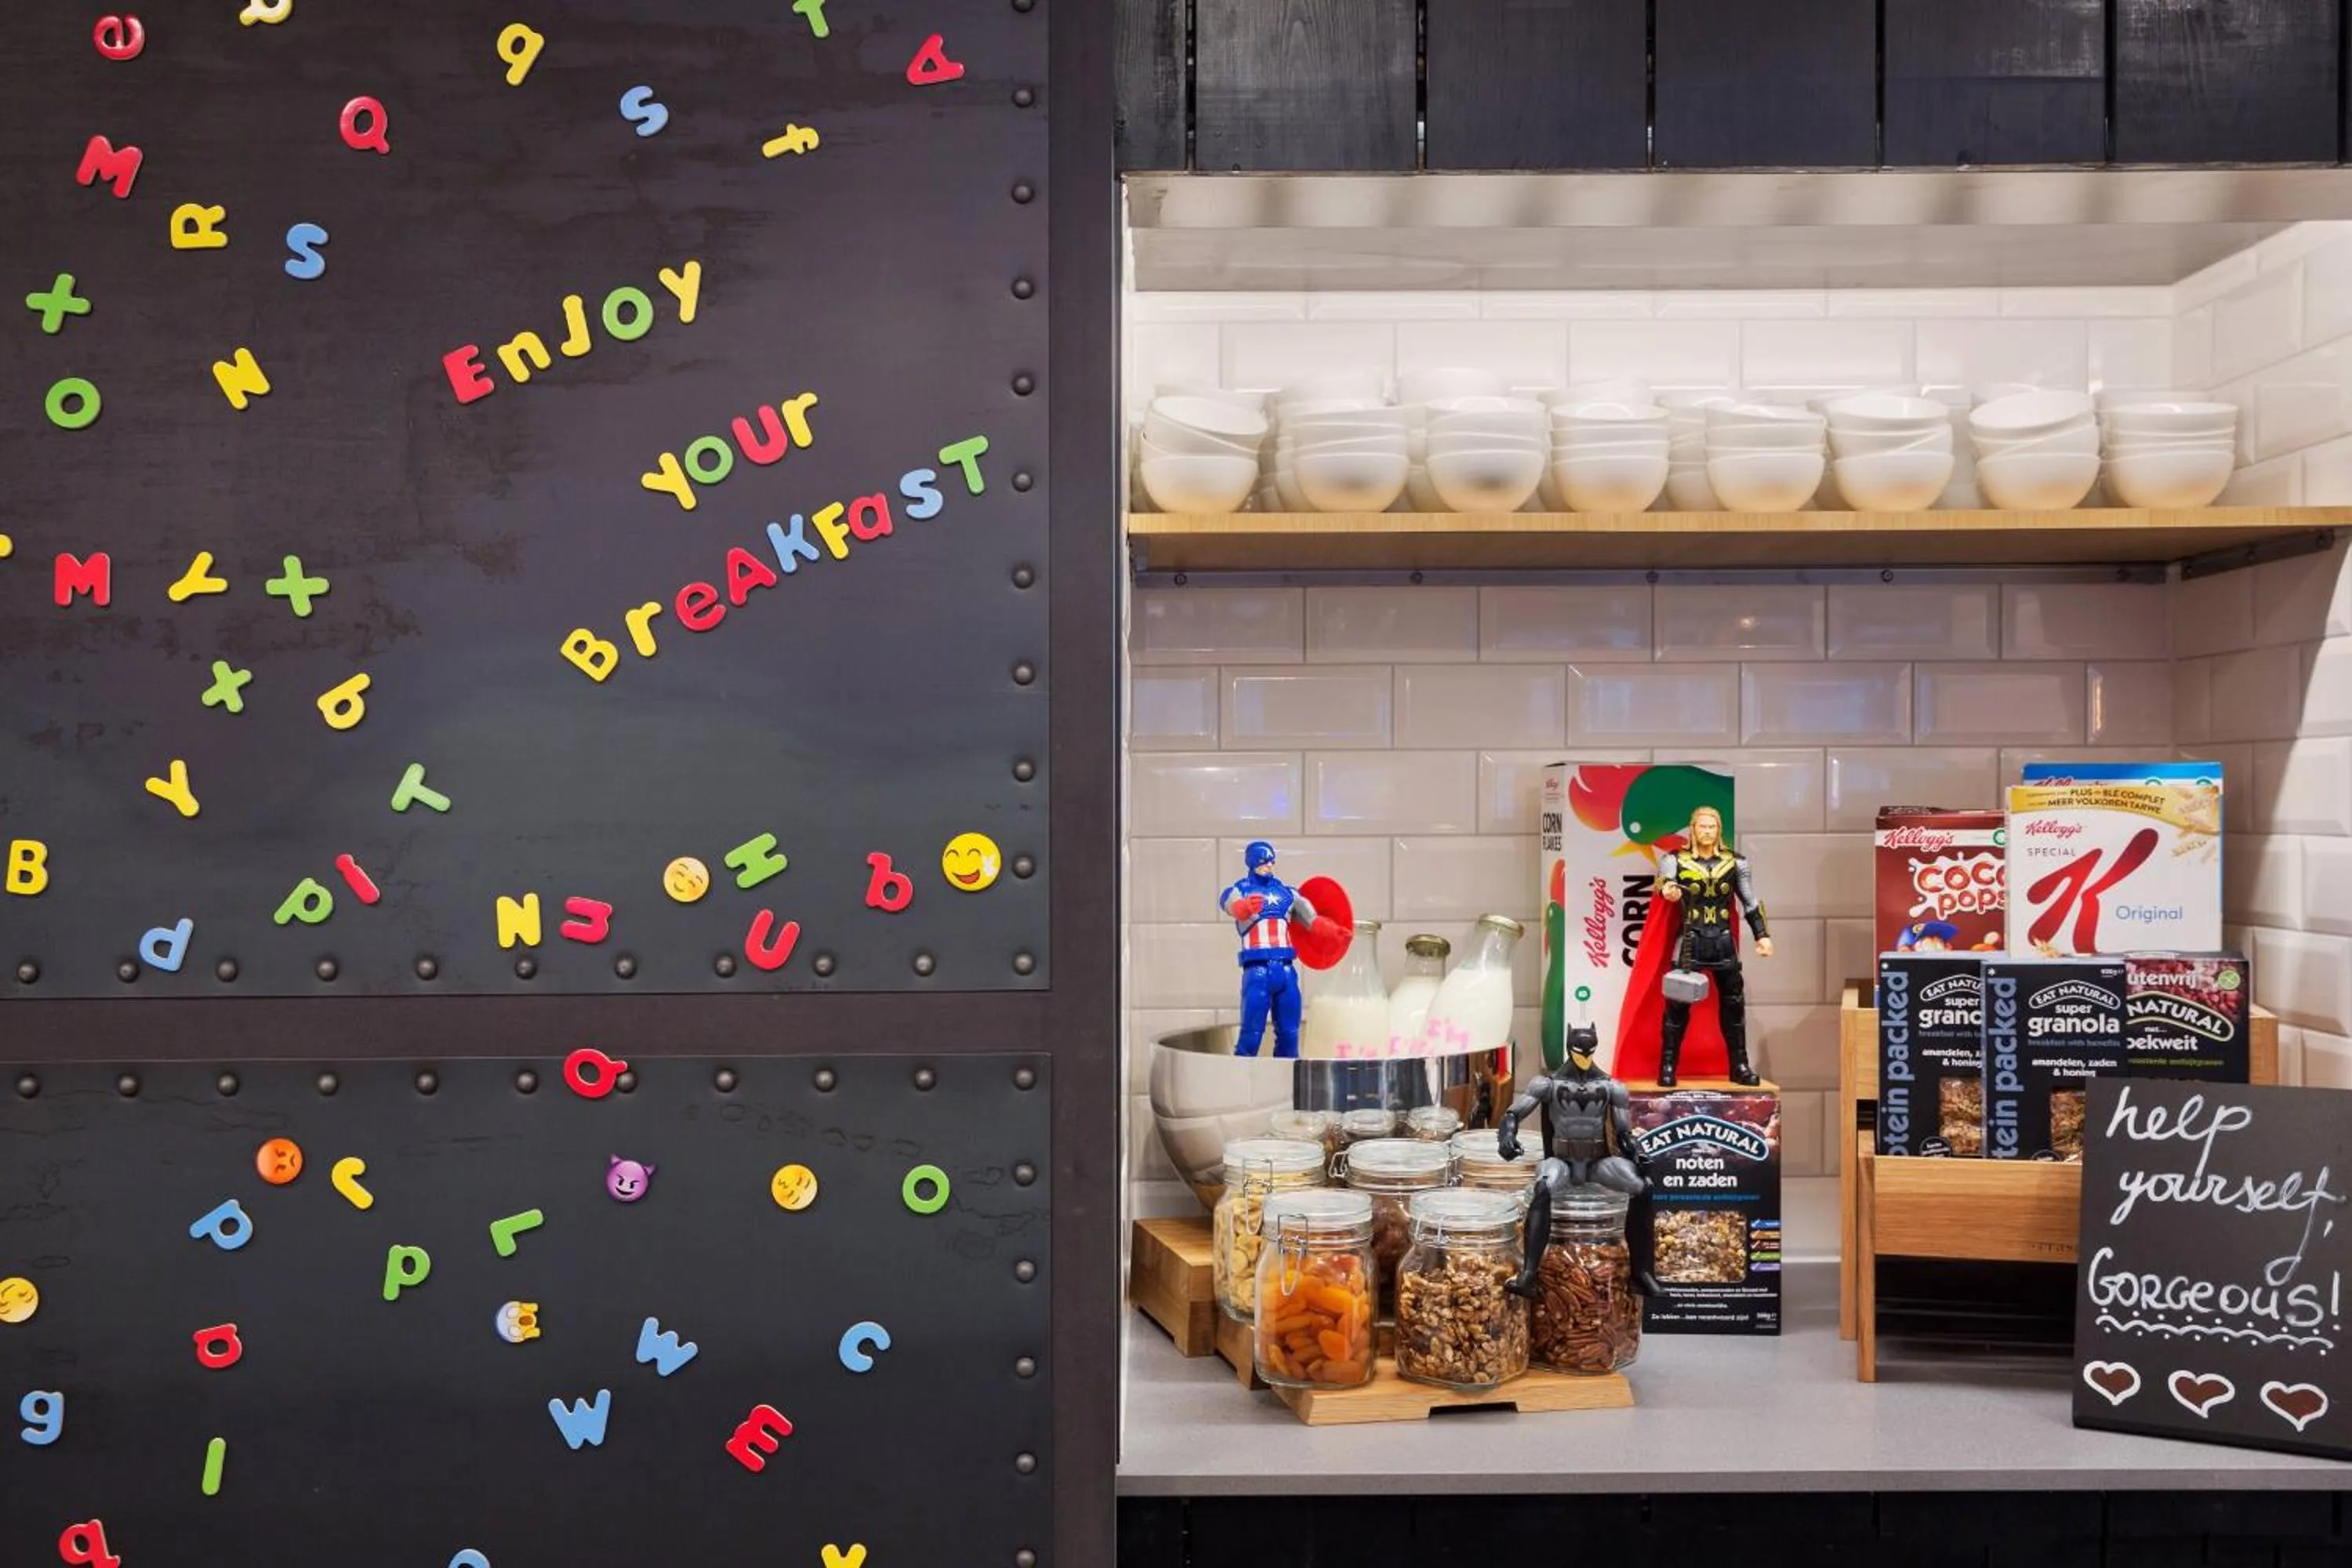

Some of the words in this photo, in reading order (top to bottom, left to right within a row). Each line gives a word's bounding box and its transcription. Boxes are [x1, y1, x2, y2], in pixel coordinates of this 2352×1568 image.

[906, 34, 964, 85] A
[339, 96, 390, 154] Q
[76, 134, 143, 198] M
[170, 203, 228, 249] R
[285, 223, 328, 280] S
[212, 347, 271, 410] N
[54, 551, 111, 606] M
[724, 832, 789, 888] H
[1883, 826, 1955, 852] Kellogg's
[2027, 848, 2076, 858] SPECIAL
[5, 839, 49, 895] B
[2027, 828, 2159, 954] K
[495, 891, 542, 949] N
[744, 908, 800, 971] U
[1583, 877, 1616, 967] Kellogg's
[2115, 905, 2183, 924] Original
[1926, 984, 1946, 997] EAT
[1944, 997, 1980, 1008] super
[2035, 991, 2057, 1005] EAT
[2059, 985, 2114, 1006] NATURAL
[2055, 1004, 2093, 1015] super
[1881, 971, 1915, 1080] packed
[1987, 978, 2024, 1091] packed
[2027, 1012, 2121, 1037] granola
[2126, 999, 2222, 1034] NATURAL
[562, 1047, 628, 1098] Q
[2031, 1058, 2086, 1069] amandelen,
[2088, 1058, 2118, 1067] zaden
[2053, 1068, 2061, 1076] &
[1641, 1130, 1672, 1153] EAT
[1675, 1122, 1759, 1154] NATURAL
[2106, 1086, 2252, 1182] help
[1663, 1175, 1684, 1187] en
[1688, 1173, 1738, 1188] zaden
[1675, 1156, 1724, 1171] noten
[383, 1245, 431, 1301] p
[20, 1390, 64, 1445] g
